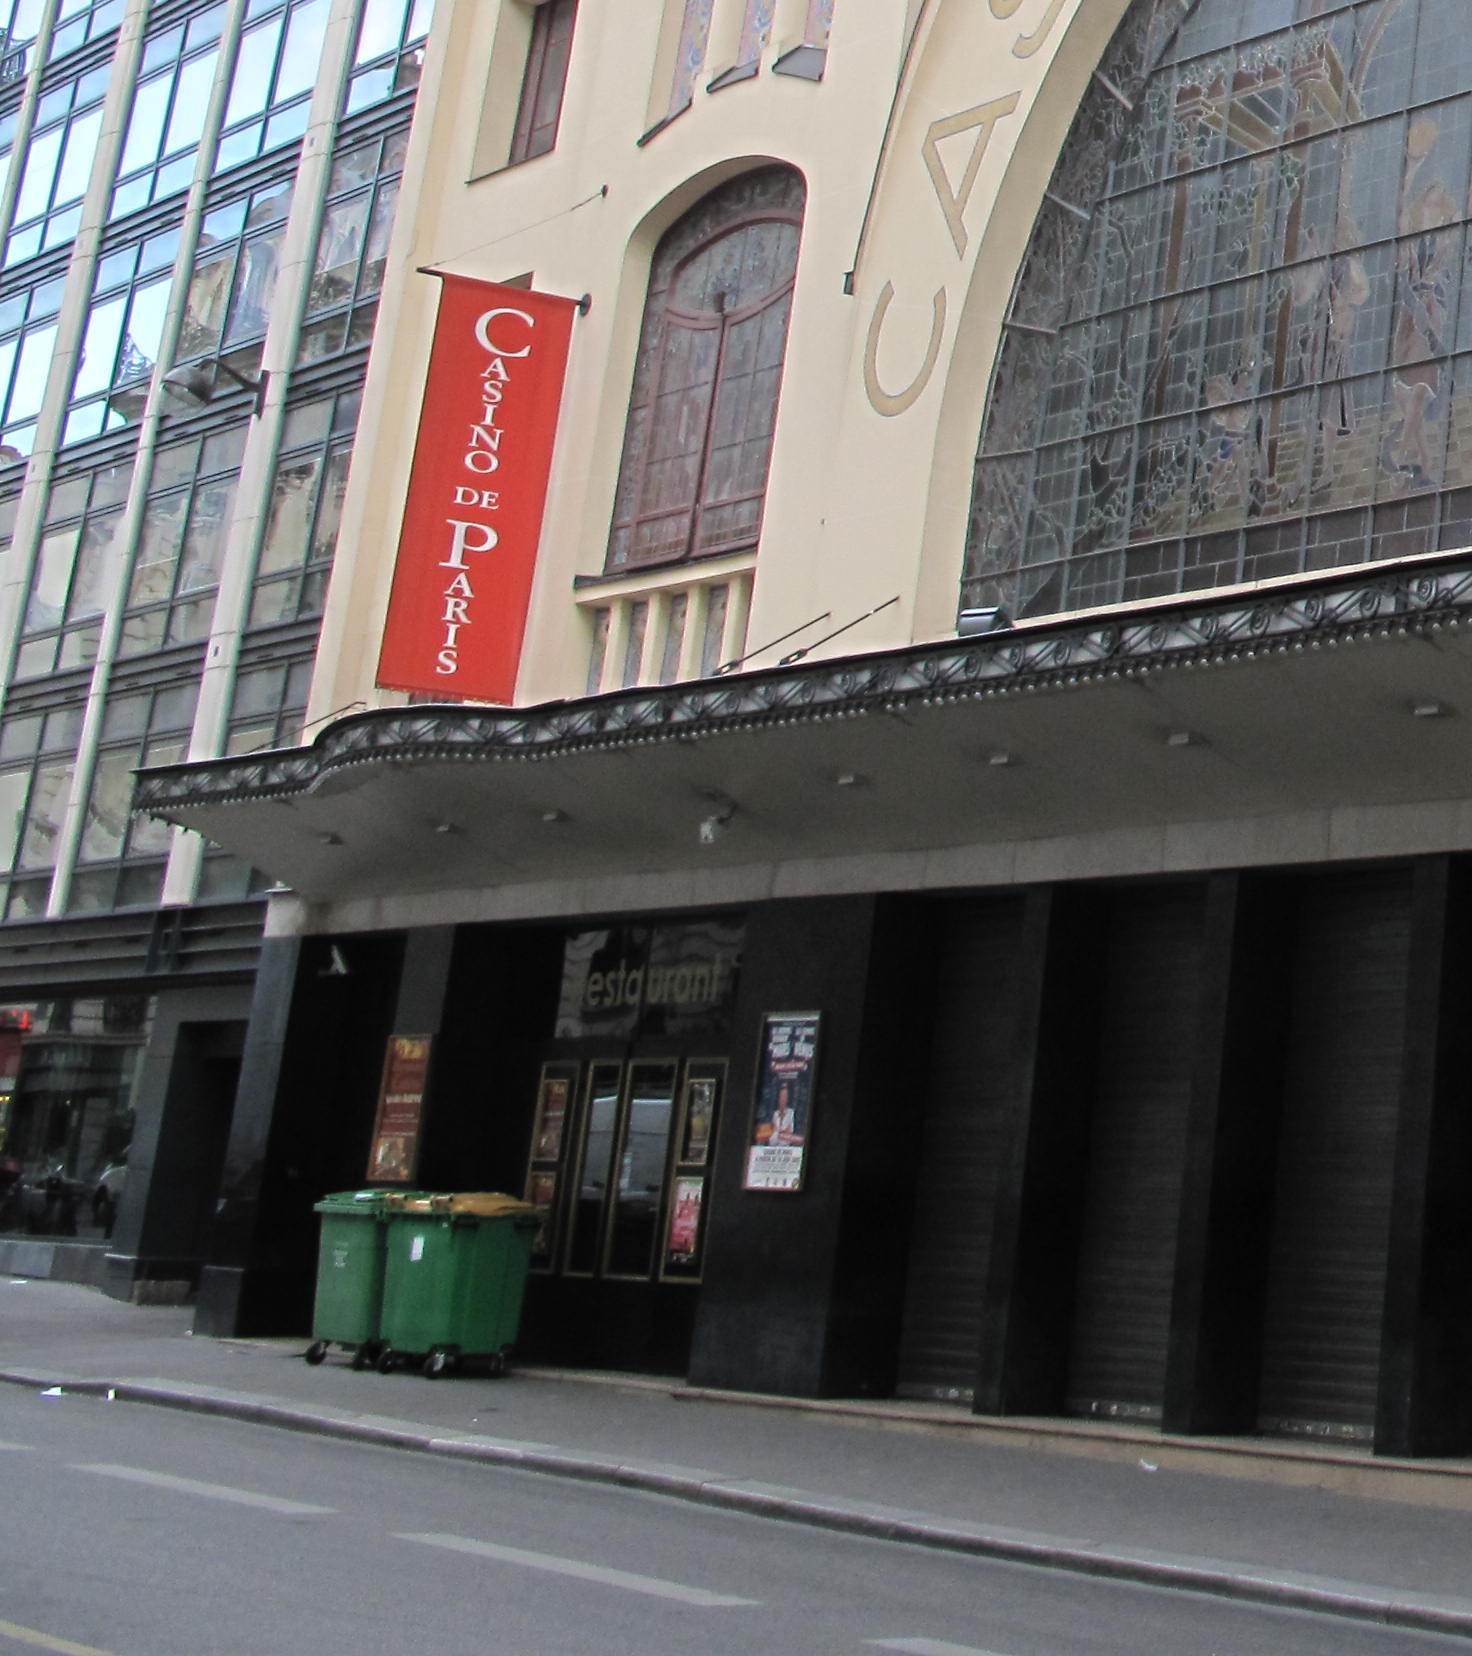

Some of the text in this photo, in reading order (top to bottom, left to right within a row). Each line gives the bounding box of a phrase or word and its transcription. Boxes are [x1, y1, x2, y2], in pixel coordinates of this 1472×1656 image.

[435, 307, 535, 675] CASINO DE PARIS
